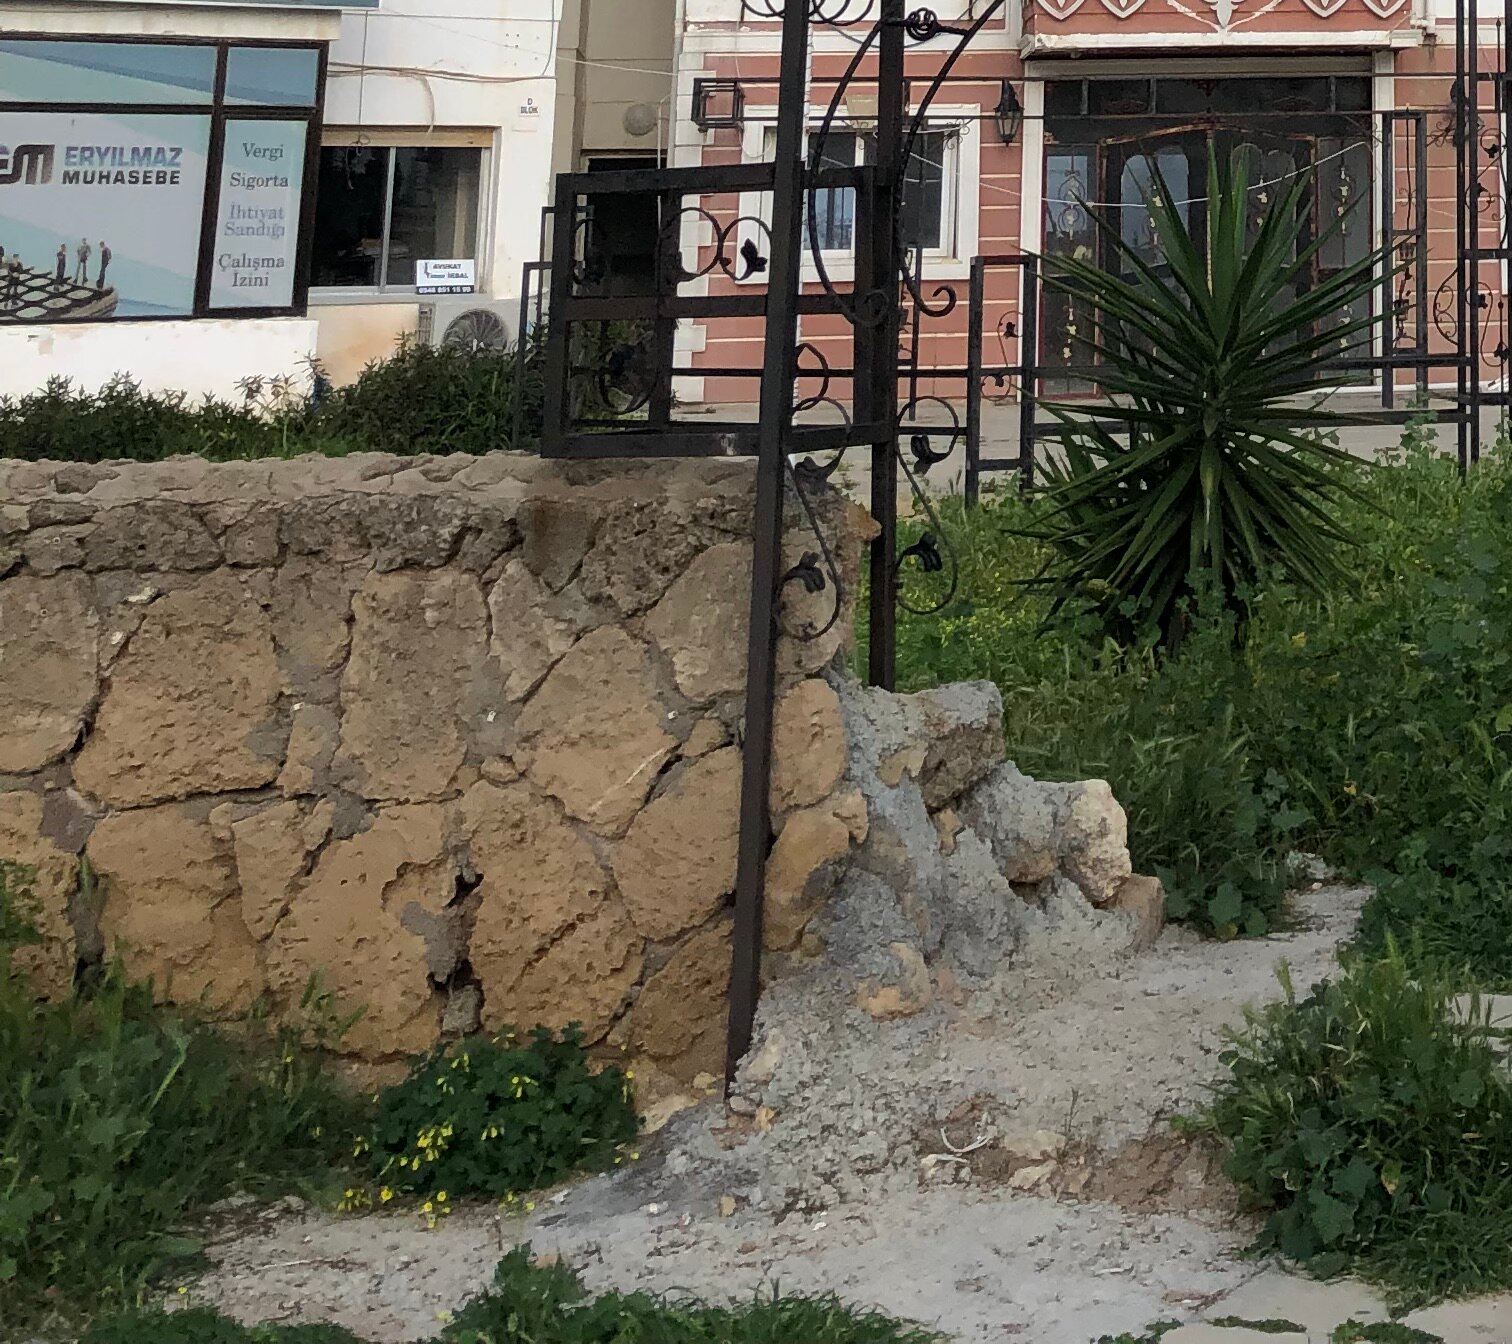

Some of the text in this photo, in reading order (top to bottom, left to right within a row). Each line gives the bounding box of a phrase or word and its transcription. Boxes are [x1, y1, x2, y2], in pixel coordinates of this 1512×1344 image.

[64, 145, 183, 167] ERYILMAZ
[242, 142, 284, 161] Vergi
[62, 170, 181, 185] MUHASEBE
[229, 171, 289, 190] Sigorta
[218, 253, 285, 272] Çalışma
